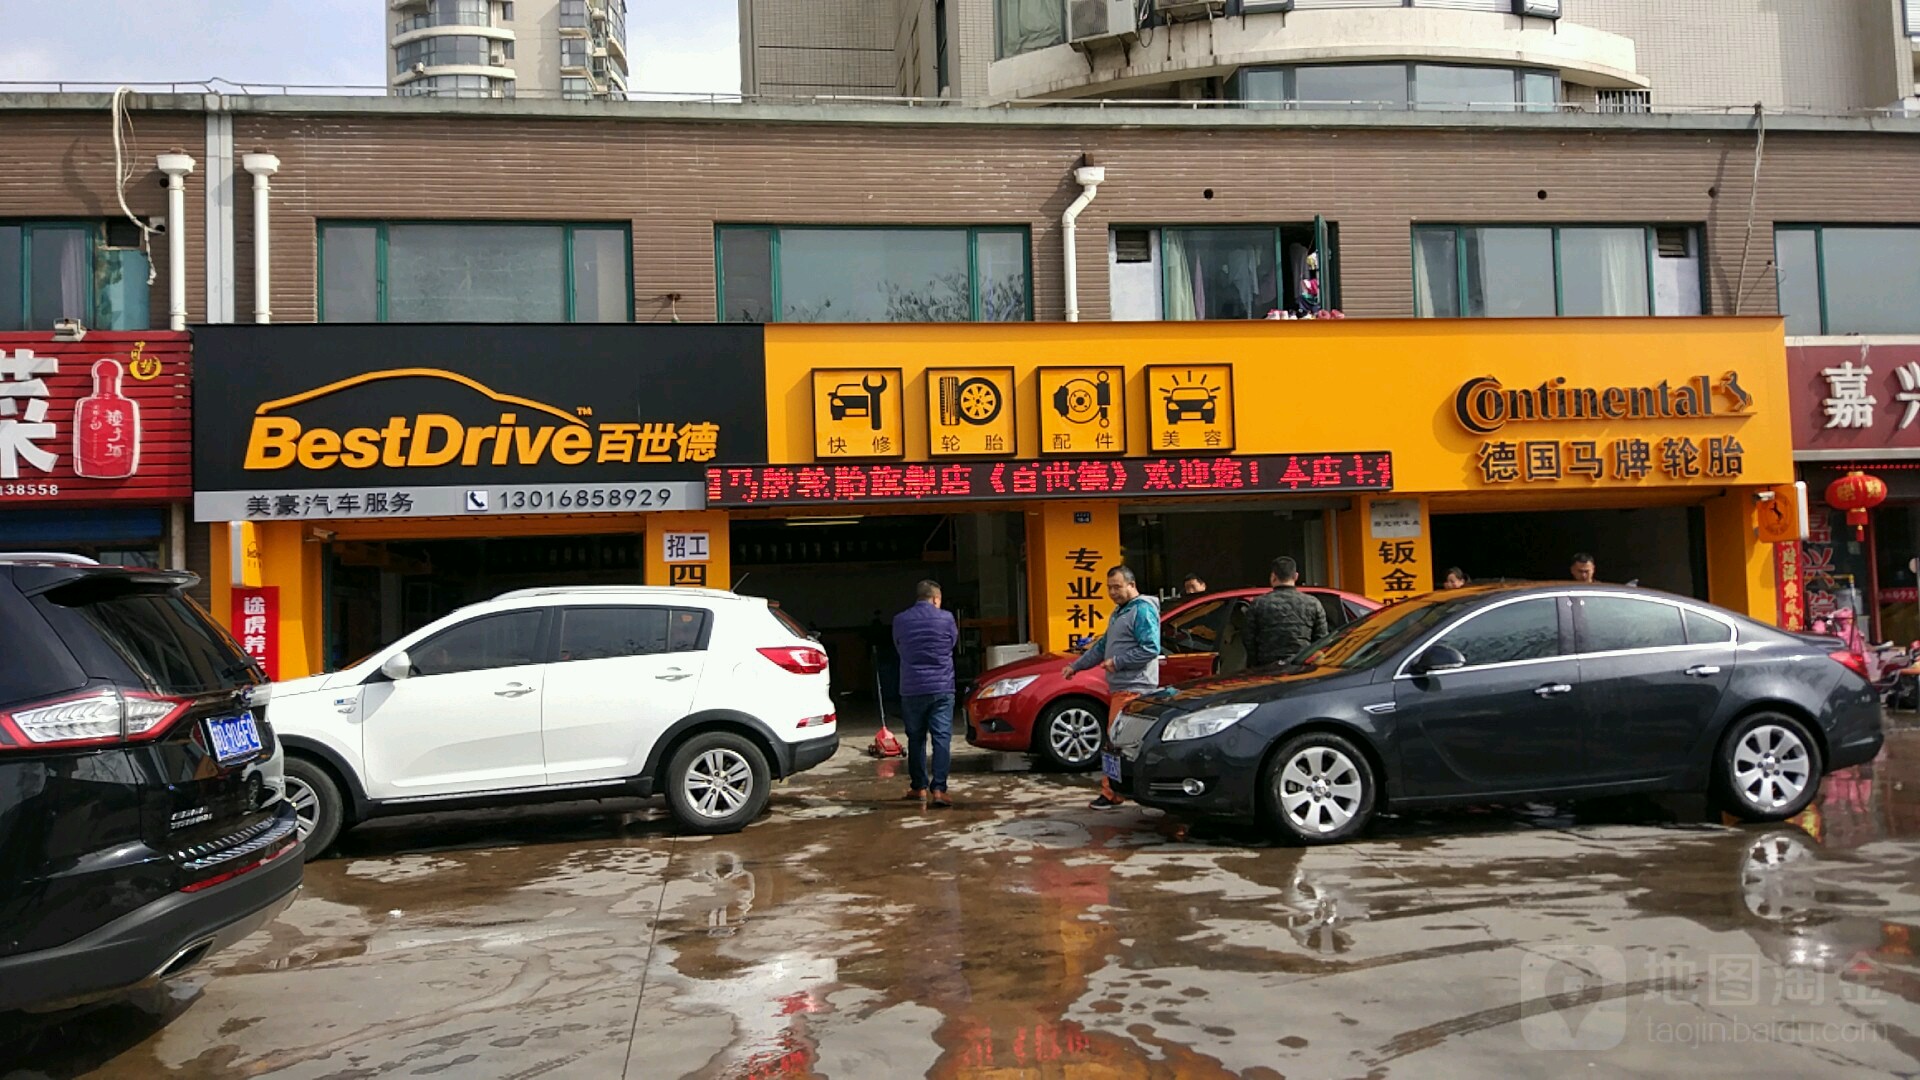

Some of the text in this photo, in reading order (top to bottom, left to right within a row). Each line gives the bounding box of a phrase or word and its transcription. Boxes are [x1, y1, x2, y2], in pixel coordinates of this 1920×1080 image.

[1456, 374, 1714, 434] Continental
[243, 413, 593, 470] BestDrive
[597, 421, 720, 463] 百世德
[828, 435, 891, 454] 快修
[941, 434, 1003, 452] 轮胎
[1052, 432, 1114, 450] 配件
[1162, 429, 1222, 448] 美容
[1478, 434, 1745, 483] 德国马牌轮胎
[247, 491, 415, 517] 美豪汽车服务
[500, 488, 672, 509] 13016858929
[667, 535, 707, 558] 招工
[669, 564, 707, 587] 四
